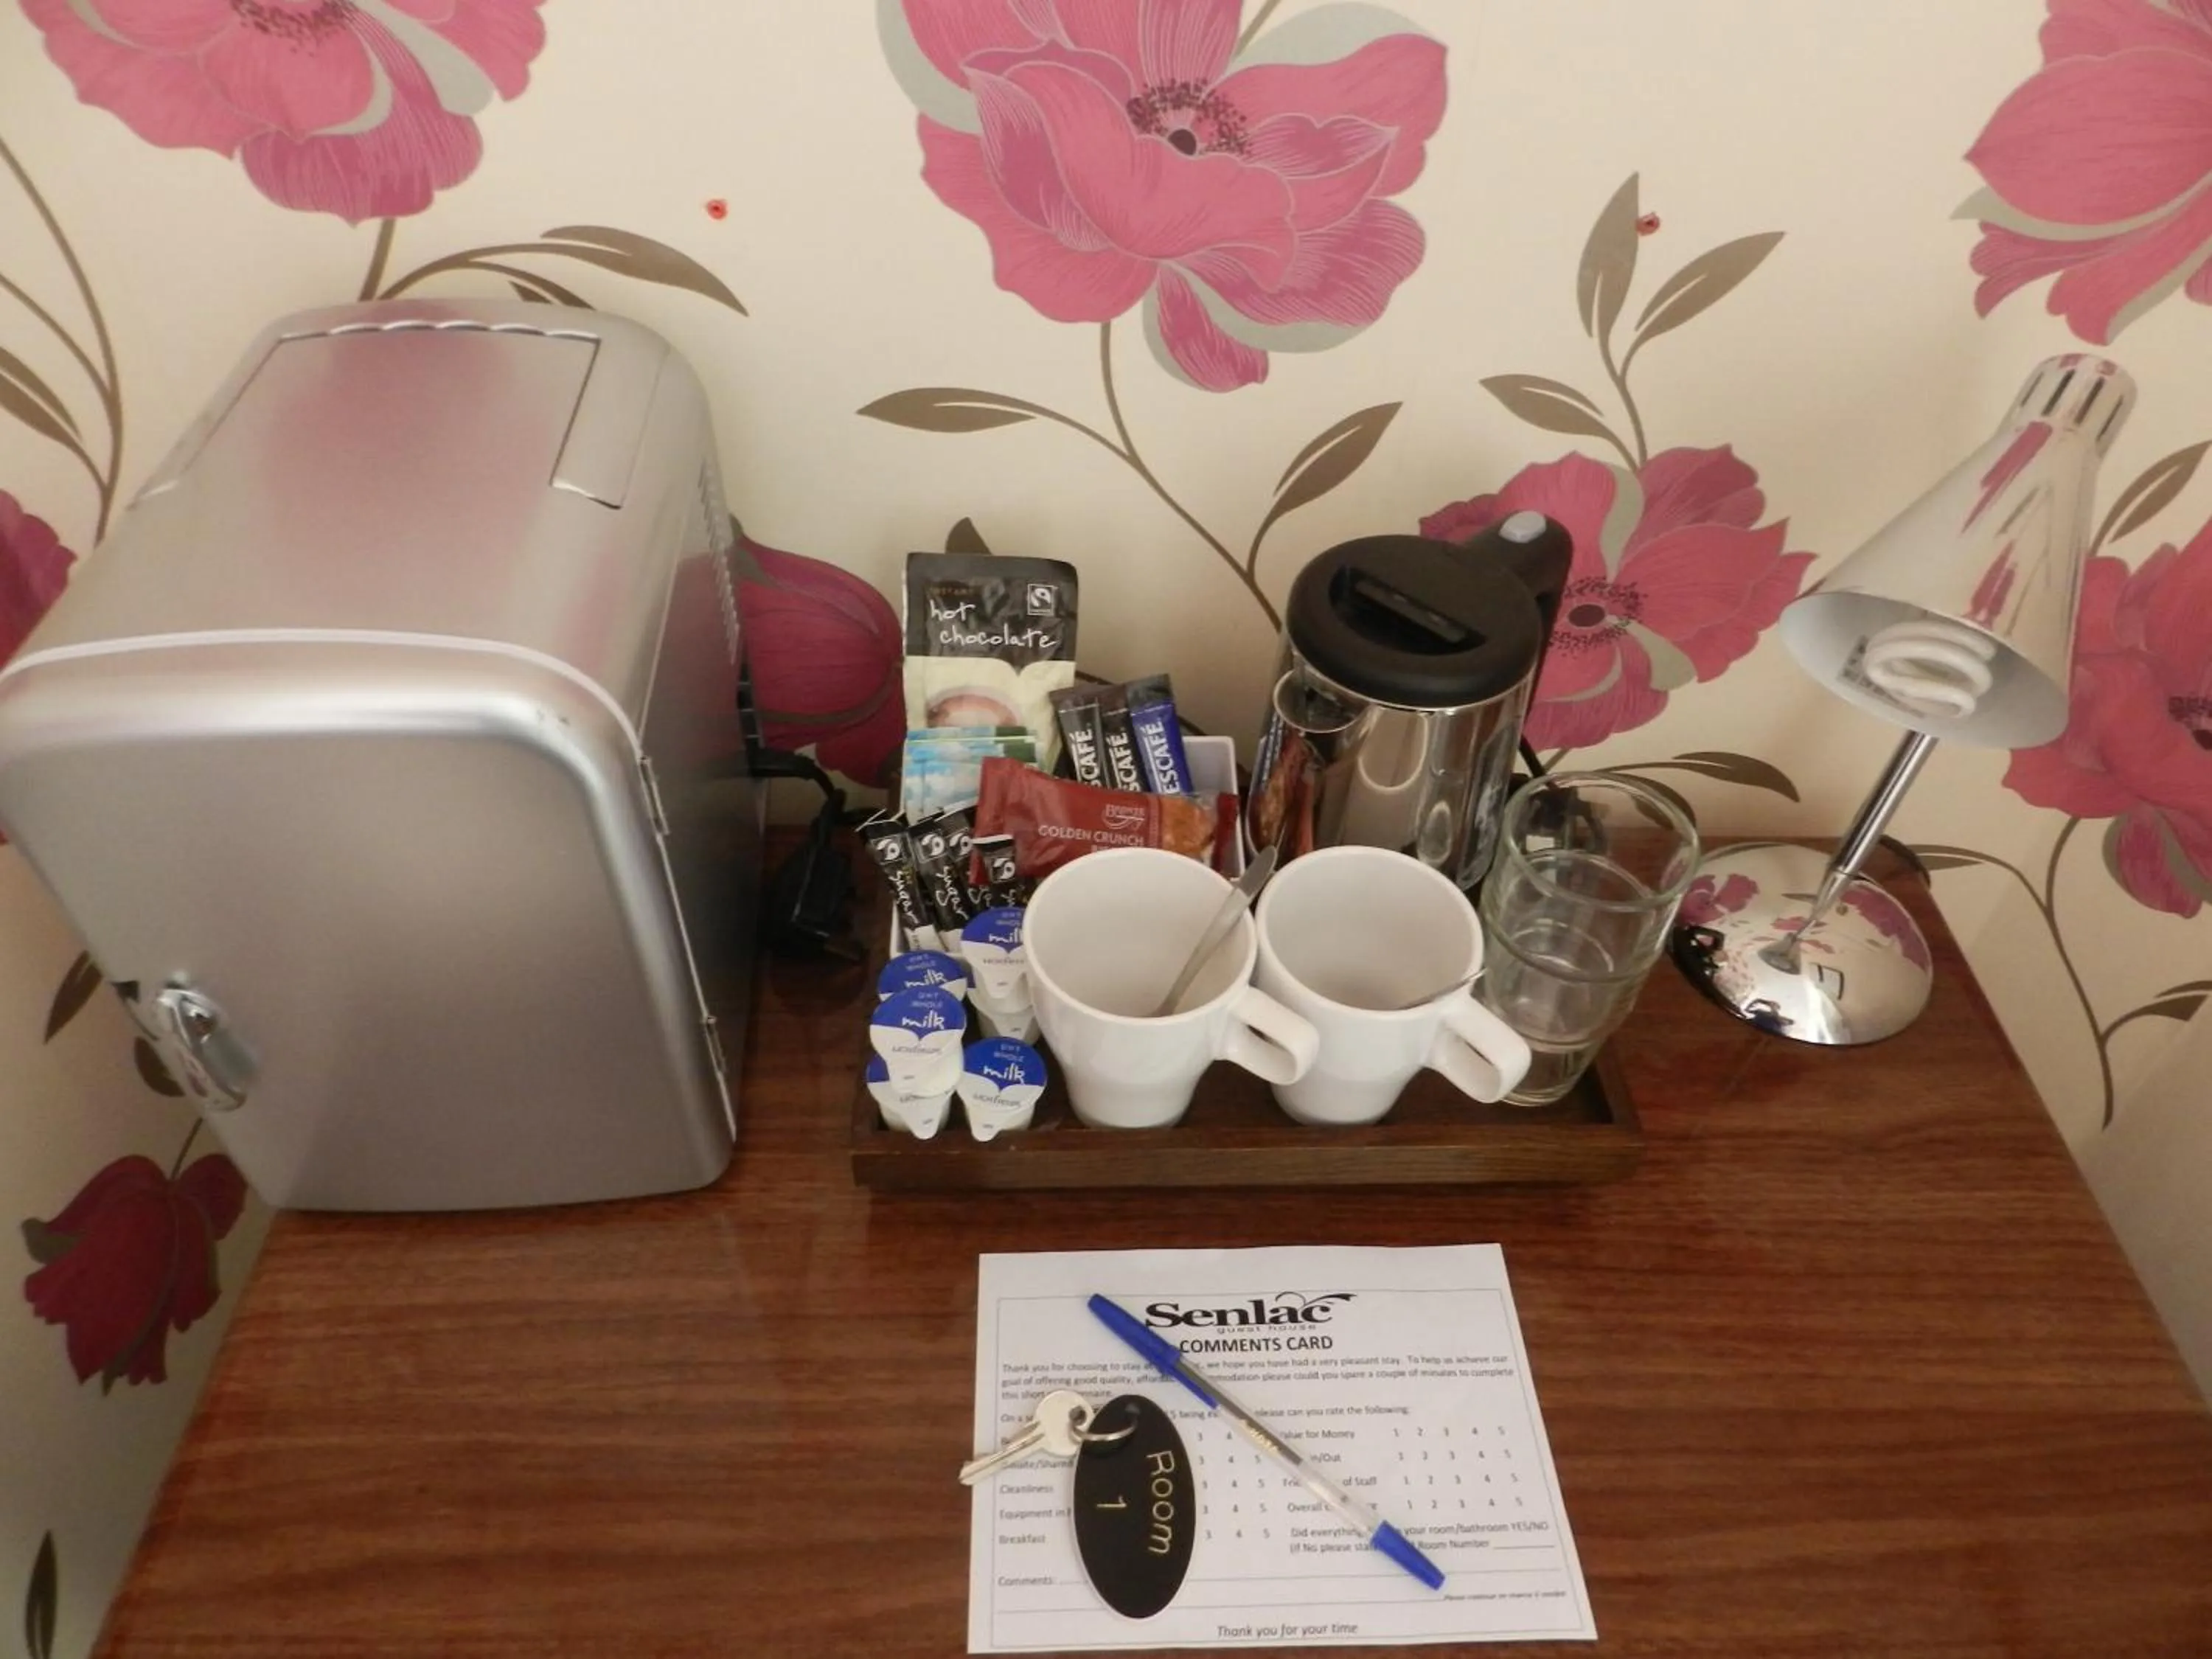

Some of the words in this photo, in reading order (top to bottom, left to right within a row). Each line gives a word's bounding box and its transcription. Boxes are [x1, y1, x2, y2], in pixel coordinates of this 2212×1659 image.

[929, 598, 975, 622] hot
[939, 622, 1057, 650] chocolate
[1106, 731, 1141, 792] SCAFÉ
[1140, 720, 1181, 794] ESCAFÉ
[1037, 824, 1091, 841] GOLDEN
[1093, 830, 1145, 846] CRUNCH
[888, 869, 920, 925] sugar
[934, 865, 970, 920] sugar
[988, 928, 1023, 944] mil
[904, 969, 947, 988] milk
[902, 1009, 945, 1030] milk
[983, 1062, 1026, 1085] milk
[1145, 1294, 1336, 1328] Senlac
[1179, 1337, 1282, 1354] COMMENTS
[1287, 1335, 1334, 1351] CARD
[1003, 1364, 1029, 1372] Thank
[1033, 1365, 1050, 1373] you
[1222, 1360, 1245, 1369] hope
[1319, 1359, 1338, 1367] very
[1340, 1357, 1380, 1366] pleasant
[1023, 1377, 1034, 1385] of
[1074, 1377, 1098, 1385] good
[1262, 1372, 1291, 1382] please
[1293, 1371, 1319, 1380] could
[1321, 1372, 1338, 1380] you
[1408, 1368, 1419, 1377] of
[1287, 1408, 1303, 1416] can
[1306, 1408, 1324, 1417] you
[1325, 1407, 1345, 1416] rate
[1347, 1406, 1363, 1415] the
[1306, 1430, 1320, 1439] for
[1321, 1429, 1355, 1439] Money
[1354, 1475, 1377, 1485] Staff
[1000, 1484, 1054, 1494] Cleanliness
[1096, 1495, 1127, 1509] 1
[1147, 1450, 1175, 1554] Room
[1287, 1502, 1323, 1512] Overall
[1000, 1509, 1052, 1520] Equipment
[1291, 1528, 1308, 1537] Did
[1403, 1526, 1426, 1535] your
[1428, 1523, 1509, 1534] room/bathroom
[1512, 1520, 1549, 1531] YES/NO
[999, 1534, 1046, 1545] Breakfast
[1418, 1540, 1447, 1550] Room
[1449, 1538, 1489, 1548] Number
[1303, 1543, 1318, 1552] No
[1320, 1543, 1352, 1553] please
[1217, 1625, 1252, 1637] Thank
[1256, 1627, 1278, 1638] you
[1280, 1624, 1298, 1637] for
[1301, 1625, 1328, 1636] your
[1332, 1623, 1358, 1634] time
